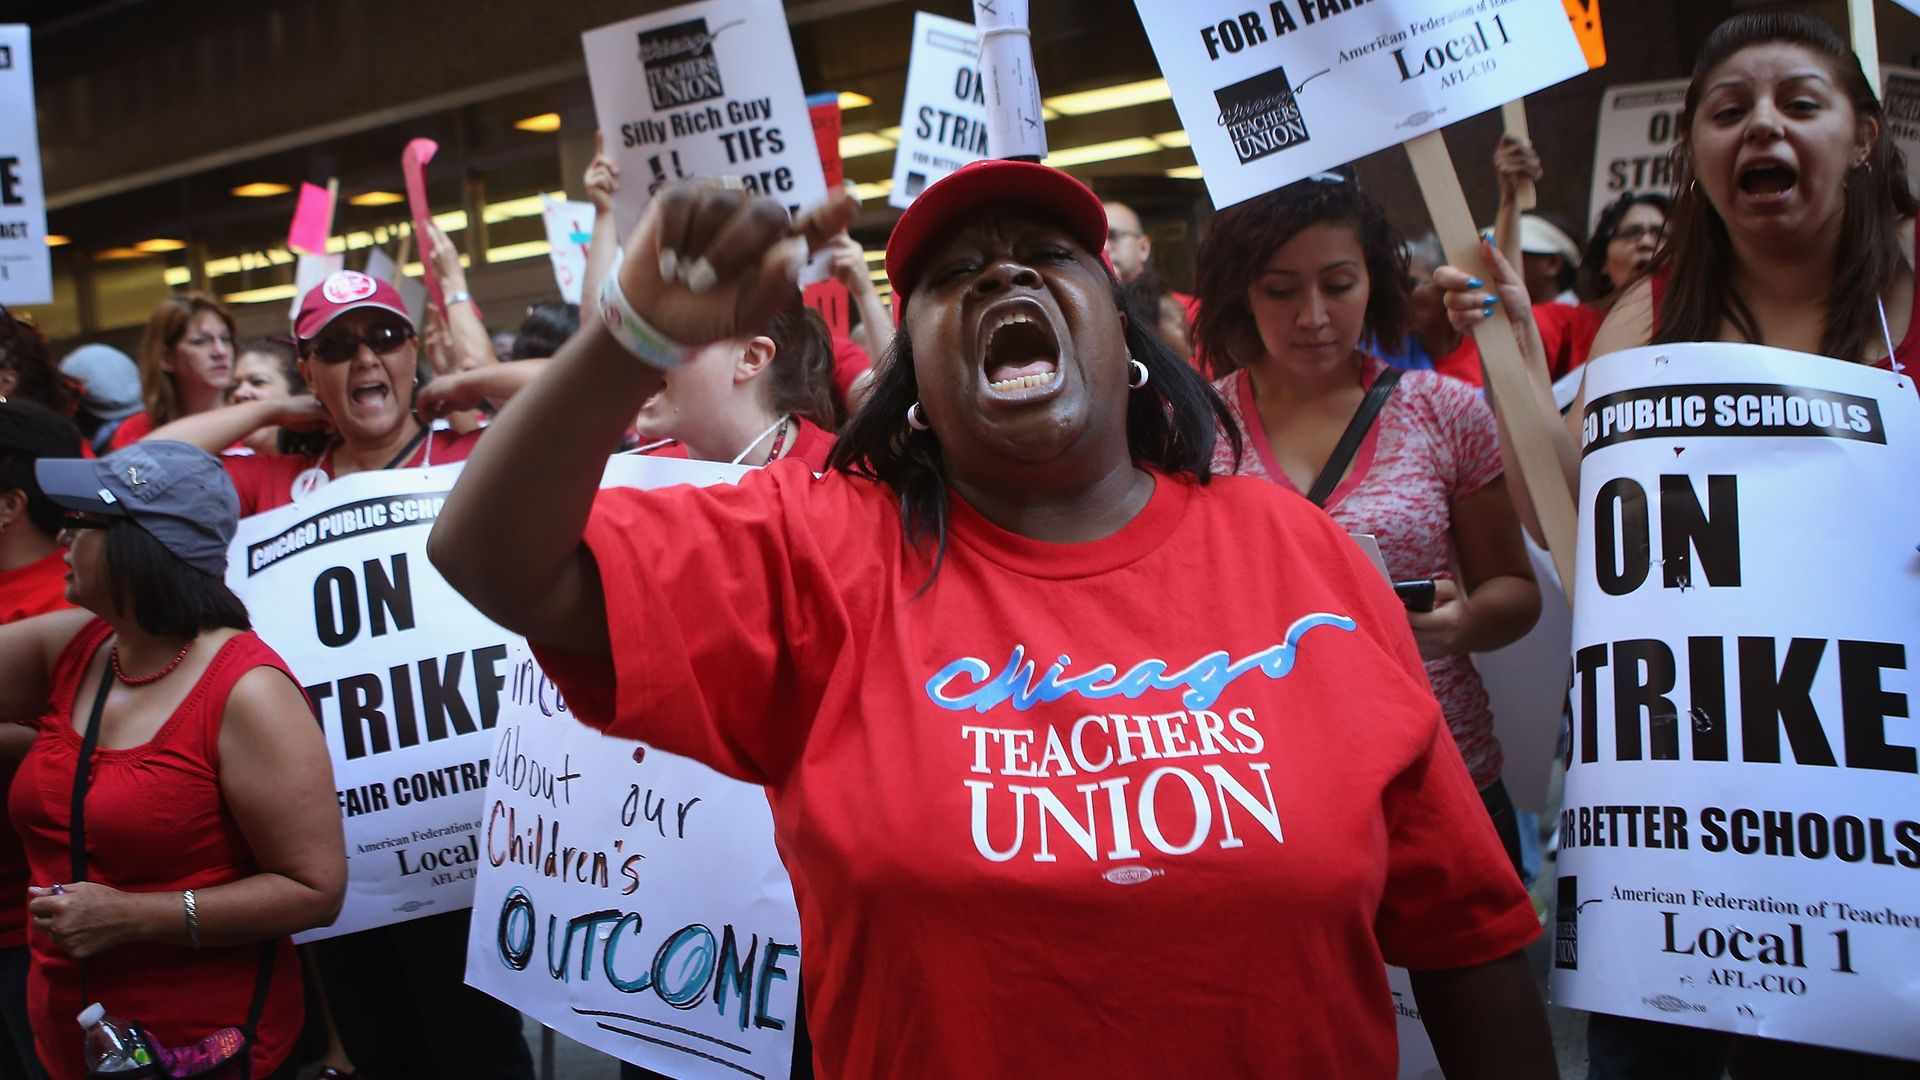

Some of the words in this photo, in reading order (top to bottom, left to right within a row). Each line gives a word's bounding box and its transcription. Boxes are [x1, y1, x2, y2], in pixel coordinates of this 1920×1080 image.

[1200, 10, 1267, 61] FOR
[1269, 0, 1298, 37] A
[1338, 31, 1407, 64] American
[1410, 8, 1474, 37] Federation
[1390, 20, 1490, 84] Local
[1493, 14, 1513, 46] 1
[651, 73, 723, 108] UNION
[1440, 58, 1498, 91] AFL-CIO
[621, 117, 666, 148] Silly
[671, 107, 722, 140] Rich
[726, 97, 772, 124] Guy
[718, 127, 786, 165] TIFs
[1229, 103, 1300, 140] TEACHERS
[1234, 119, 1306, 159] UNION
[742, 166, 793, 196] are
[1602, 395, 1706, 439] PUBLIC
[1714, 395, 1872, 433] SCHOOLS
[252, 521, 317, 573] CHICAGO
[318, 504, 387, 540] PUBLIC
[1594, 474, 1742, 596] ON
[313, 552, 416, 648] ON
[925, 612, 1357, 714] Chicago
[961, 708, 1266, 779] TEACHERS
[496, 726, 582, 808] about
[621, 783, 702, 839] our
[356, 834, 410, 855] American
[411, 821, 475, 843] Federation
[963, 763, 1285, 863] UNION
[1579, 805, 1689, 850] BETTER
[1700, 807, 1920, 869] SCHOOLS
[395, 835, 479, 877] Local
[487, 800, 647, 896] Children's
[1610, 885, 1686, 907] American
[1691, 889, 1800, 917] Federation
[1806, 900, 1829, 919] of
[498, 885, 800, 1033] OUTCOME
[1660, 911, 1808, 969] Local
[1827, 929, 1859, 976] 1
[1706, 967, 1808, 997] AFL-CIO
